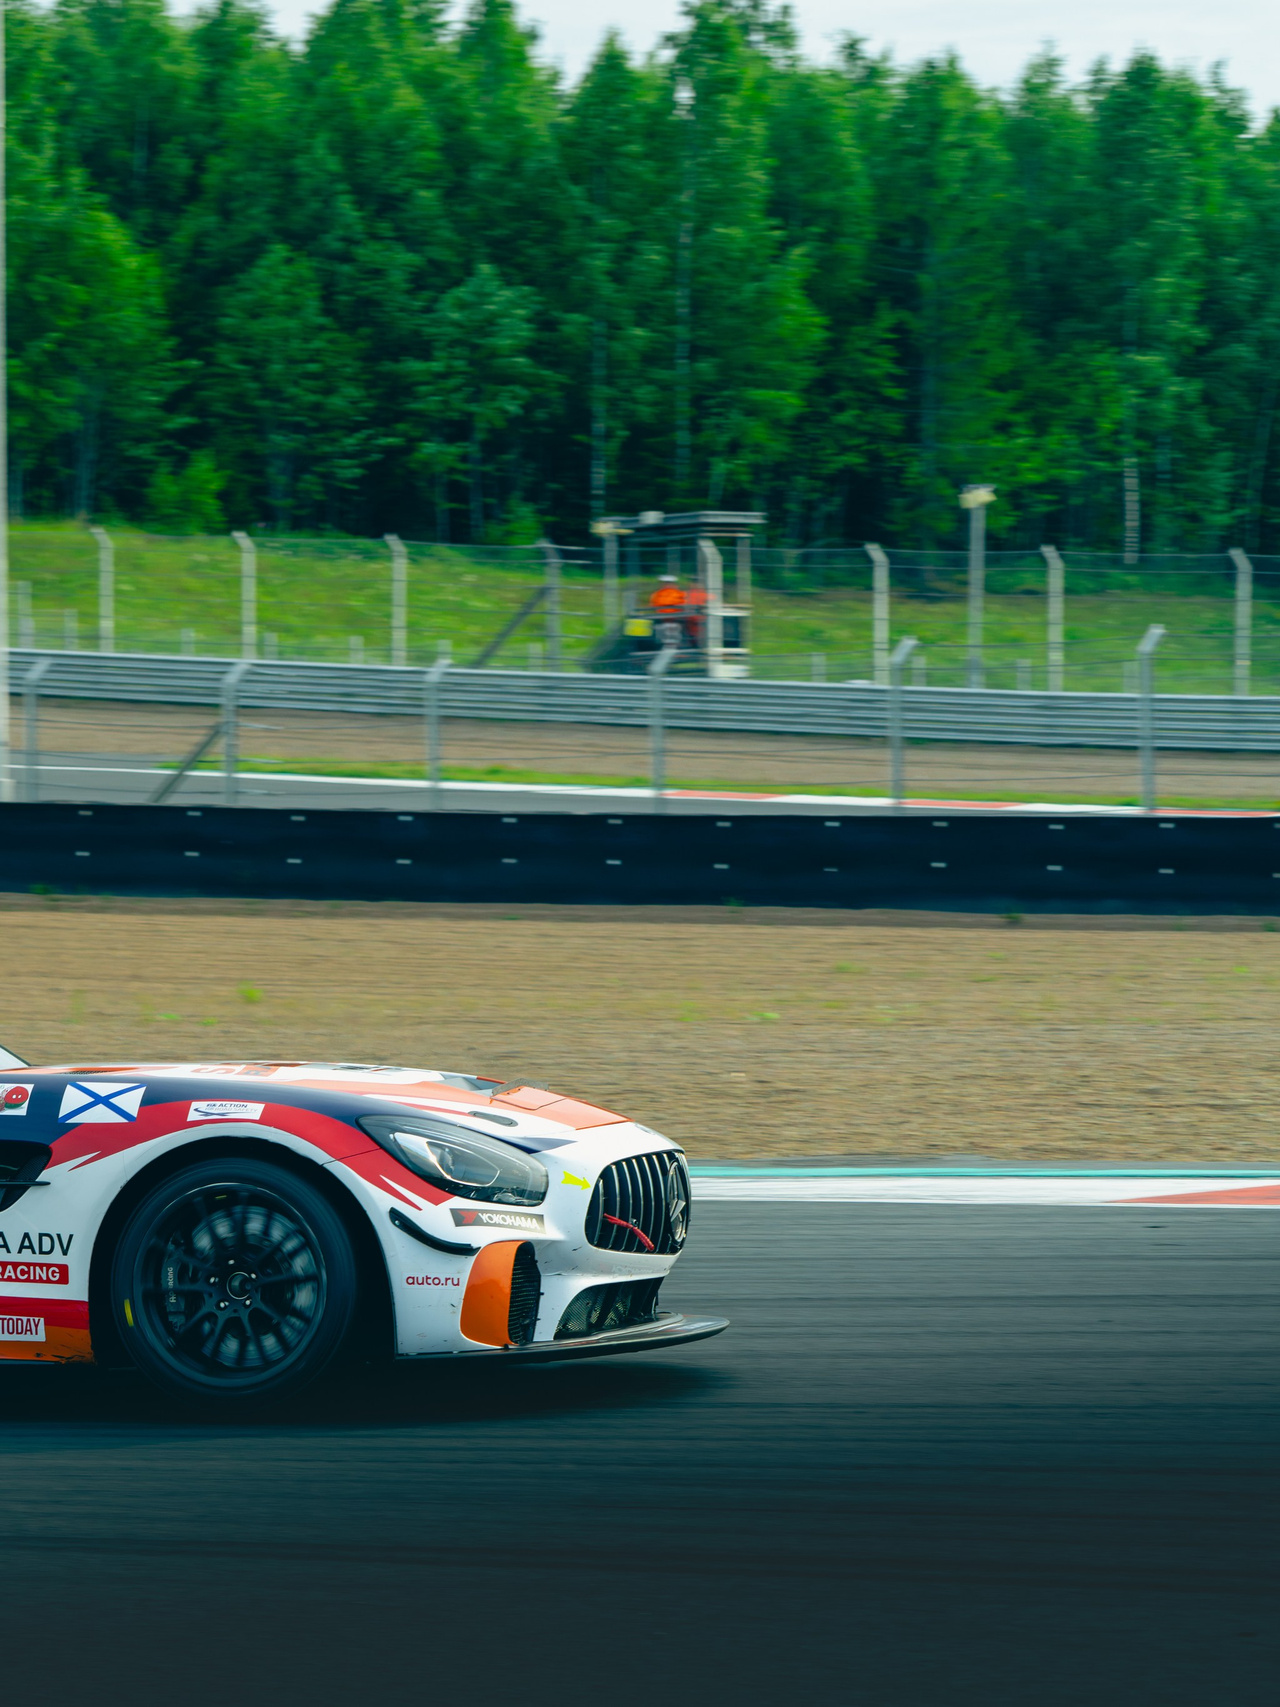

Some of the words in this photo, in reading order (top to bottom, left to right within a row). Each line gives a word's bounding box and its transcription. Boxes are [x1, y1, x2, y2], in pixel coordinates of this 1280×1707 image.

[478, 1212, 540, 1230] YOKOHAMA
[17, 1232, 74, 1256] ADV
[405, 1275, 460, 1287] auto.ru
[0, 1317, 41, 1336] TODAY
